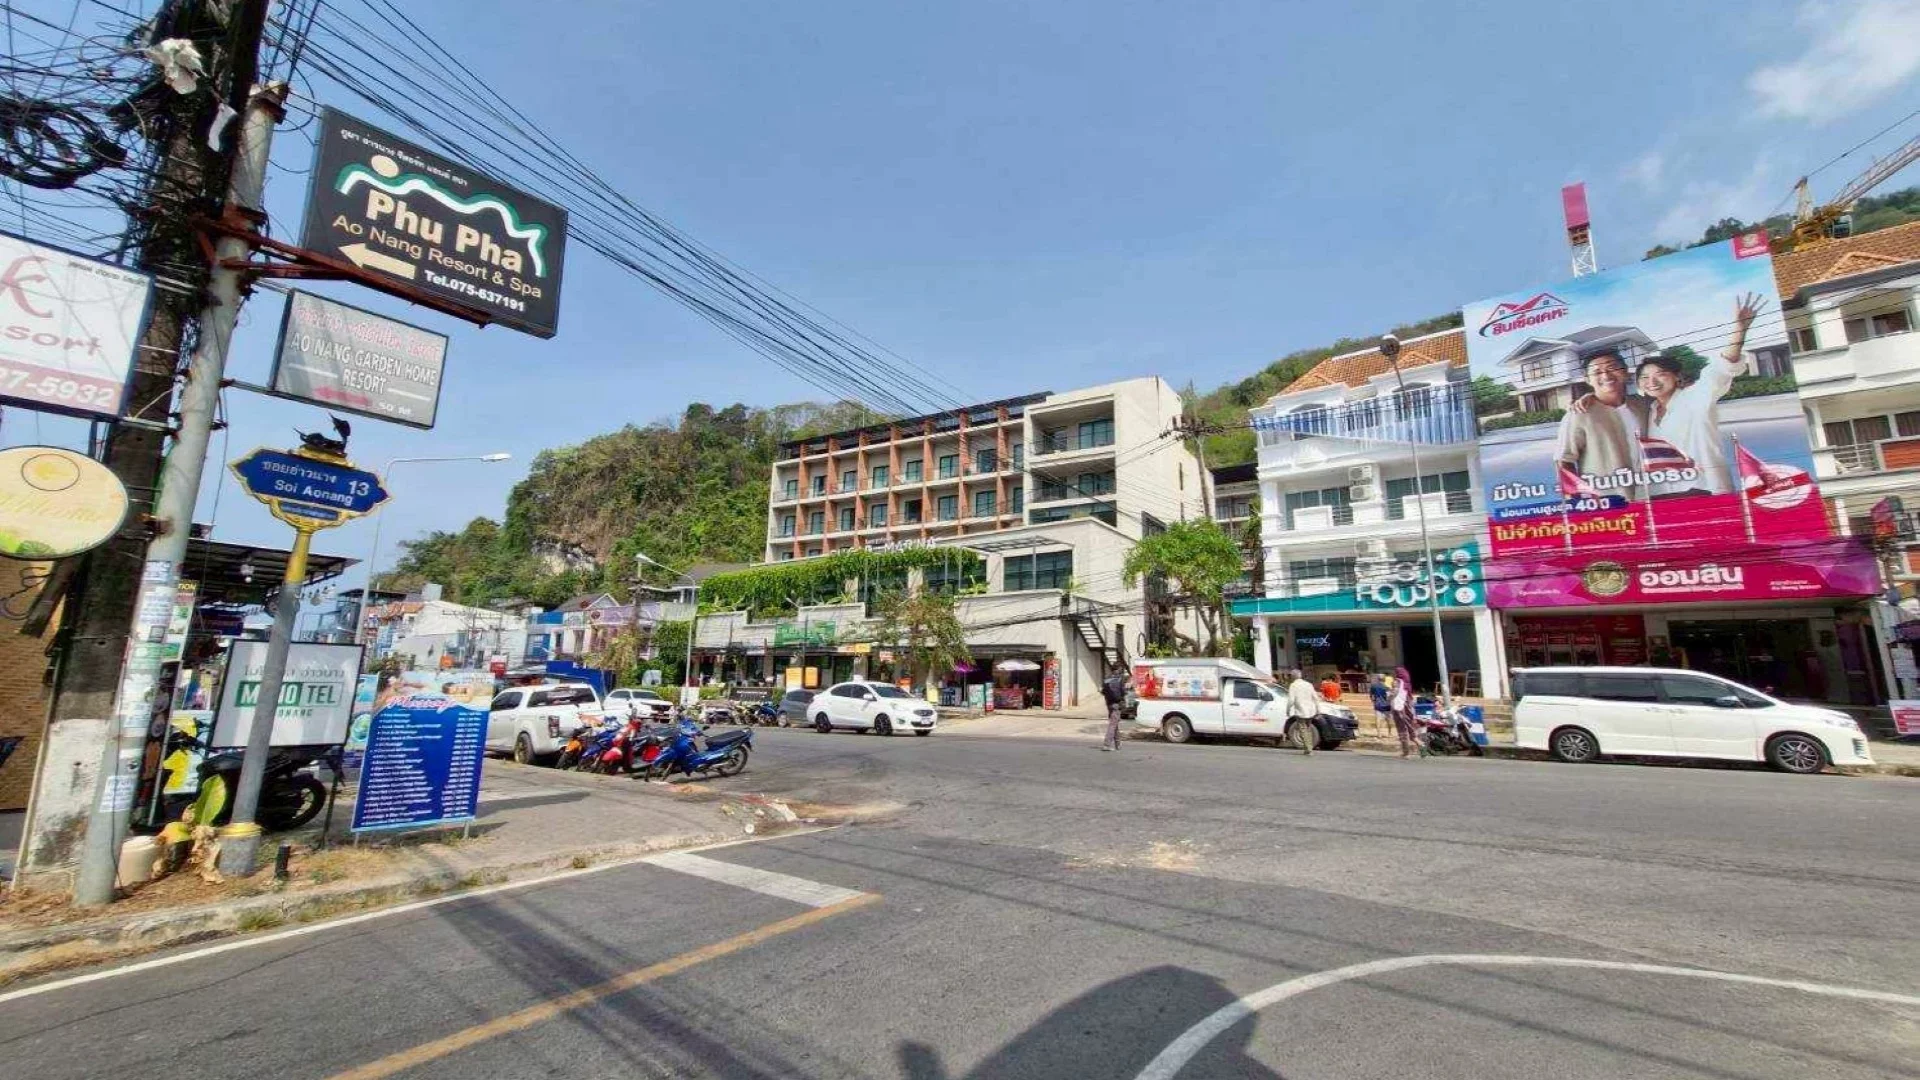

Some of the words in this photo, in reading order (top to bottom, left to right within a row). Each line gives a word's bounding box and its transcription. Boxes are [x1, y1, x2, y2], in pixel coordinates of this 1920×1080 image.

[366, 188, 444, 245] Phu
[456, 223, 524, 275] Pha
[332, 215, 363, 236] Ao
[369, 228, 422, 260] Nang
[428, 246, 488, 280] Resort
[492, 270, 505, 286] &
[510, 277, 543, 299] Spa
[424, 270, 526, 312] Tel.075-637191
[290, 331, 311, 352] AO
[314, 338, 351, 364] NANG
[354, 349, 401, 377] GARDEN
[404, 363, 437, 386] HOME
[341, 368, 387, 395] RESORT
[262, 461, 338, 484] ซอยอ่าวนาง
[348, 480, 370, 497] 13
[274, 479, 298, 493] Soi
[302, 485, 354, 507] Aonang
[1494, 482, 1546, 501] มีบ้าน
[1575, 499, 1598, 512] 40
[1638, 563, 1744, 587] ออมสิน
